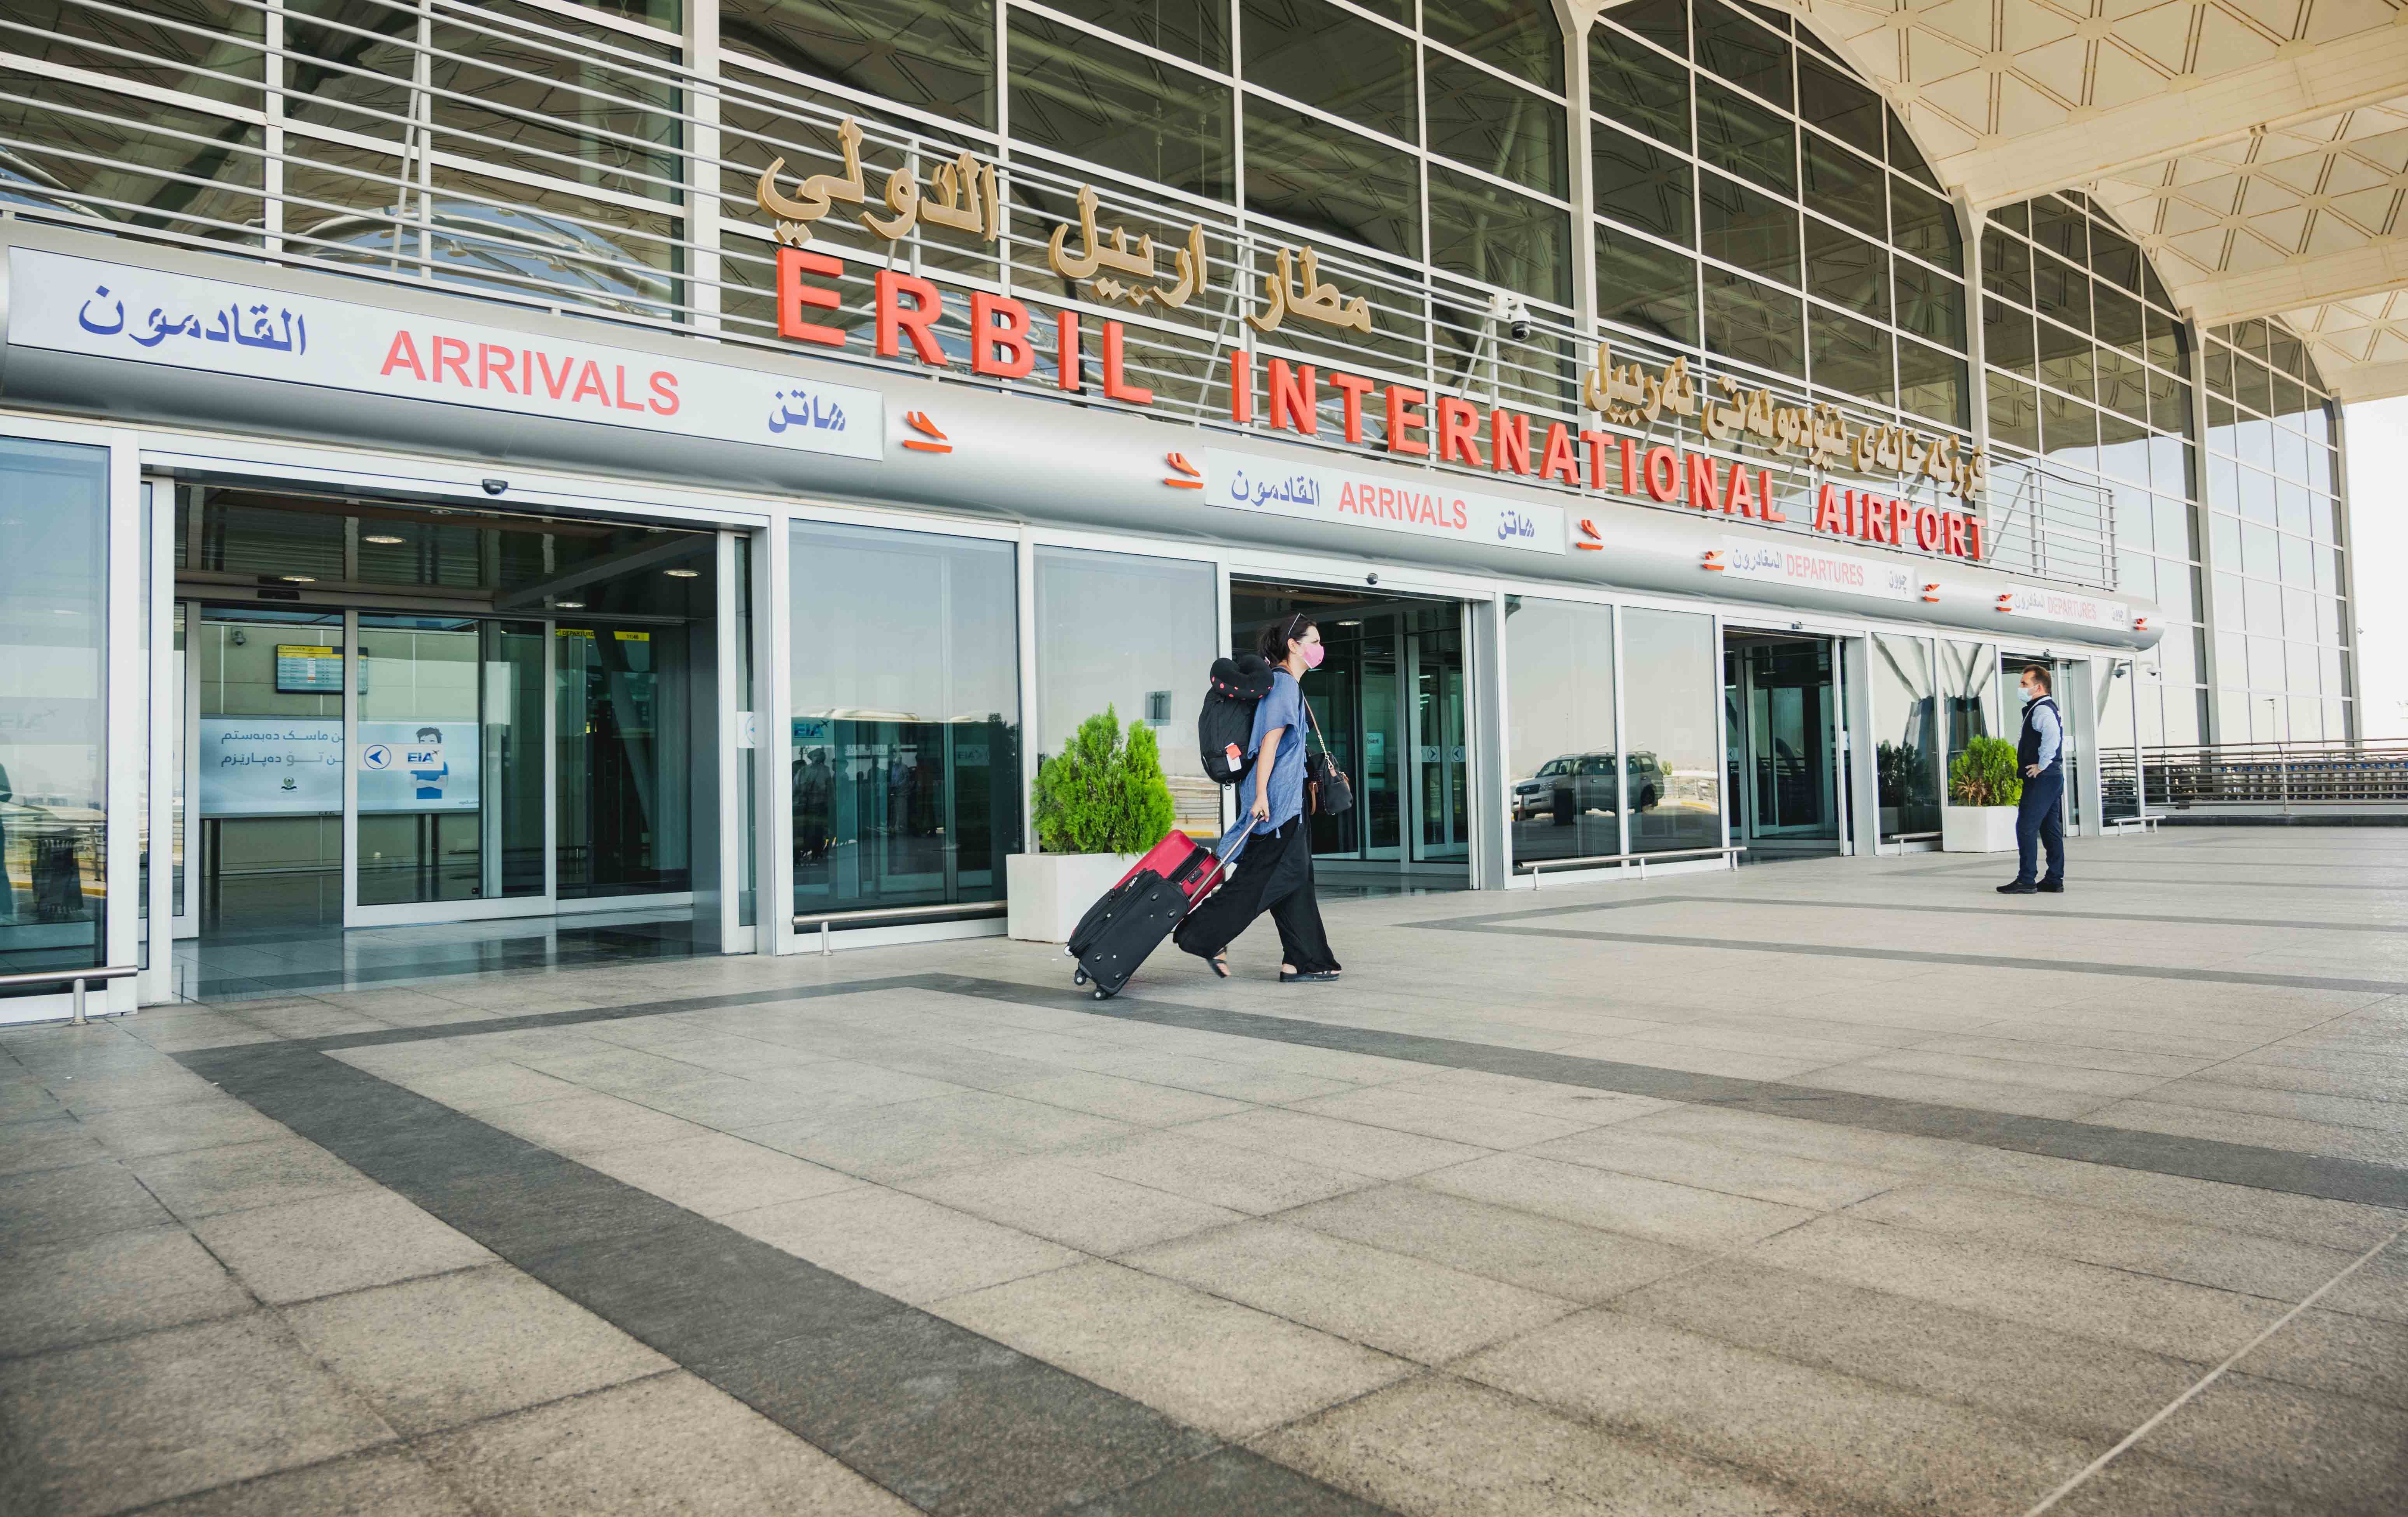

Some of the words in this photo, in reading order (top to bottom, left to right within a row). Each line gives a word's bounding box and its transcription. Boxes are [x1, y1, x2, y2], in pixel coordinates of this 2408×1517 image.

[757, 117, 998, 247] الدولي
[1049, 184, 1207, 307] اربيل
[1244, 245, 1371, 333] مطار
[79, 285, 306, 355] القادمون
[380, 330, 680, 415] ARRIVALS
[768, 389, 845, 433] هاتن
[777, 247, 1153, 404] ERBIL
[1232, 350, 1786, 522] INTERNATIONAL
[1815, 483, 1986, 560] AIRPORT
[1231, 470, 1319, 506] القادمون
[1338, 482, 1467, 529] ARRIVALS
[1498, 512, 1534, 540] هاتن
[1786, 554, 1864, 586] DEPARTURES
[2048, 597, 2096, 620] DEPARTURES
[794, 723, 824, 736] EIA
[408, 753, 434, 762] EIA
